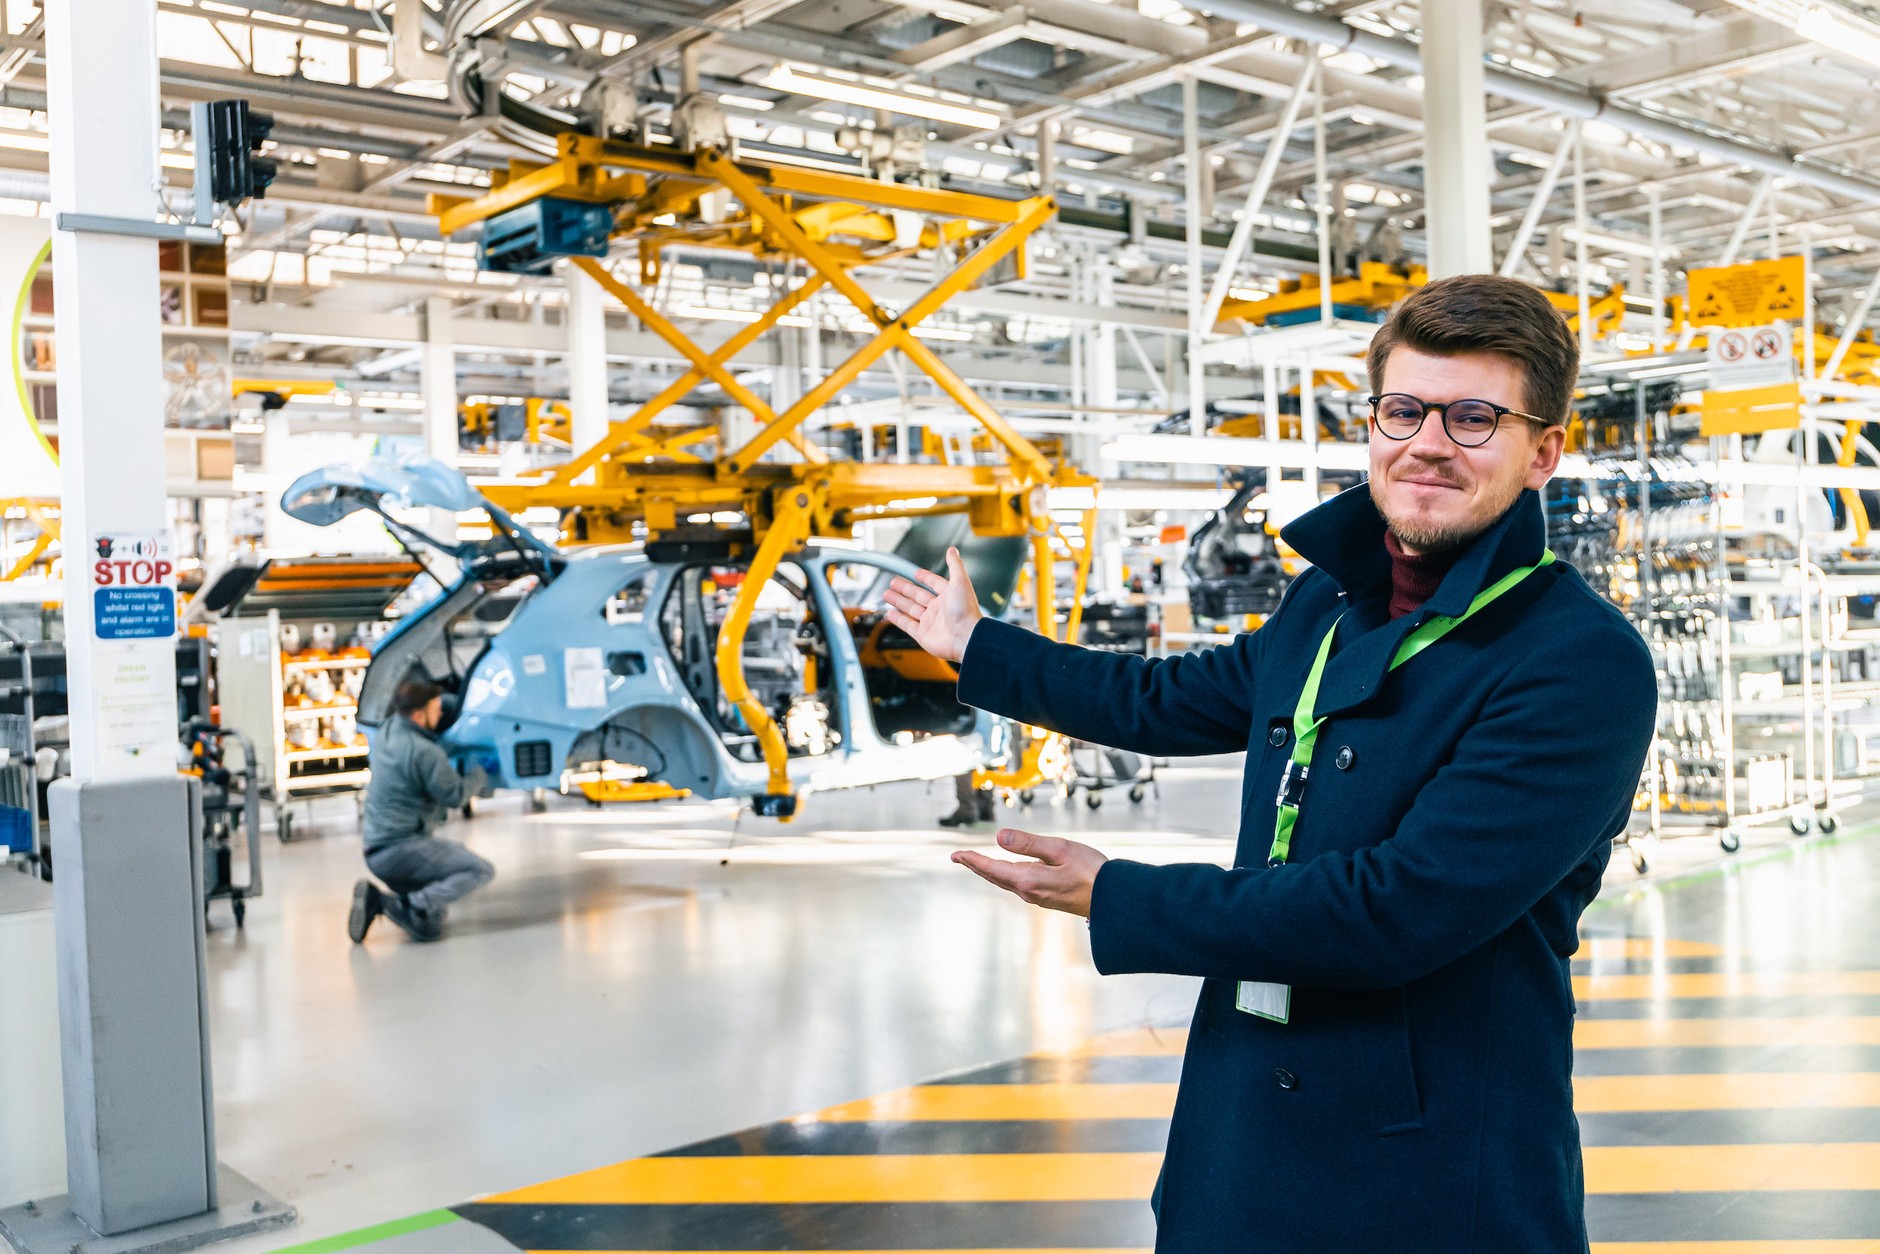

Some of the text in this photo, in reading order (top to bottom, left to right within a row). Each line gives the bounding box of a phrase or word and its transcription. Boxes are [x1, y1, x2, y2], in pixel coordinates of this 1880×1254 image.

[567, 135, 579, 157] 2
[94, 559, 173, 585] STOP
[109, 591, 160, 601] No crossing
[105, 603, 165, 613] whilst red light
[101, 616, 118, 624] and
[119, 615, 144, 624] alarm
